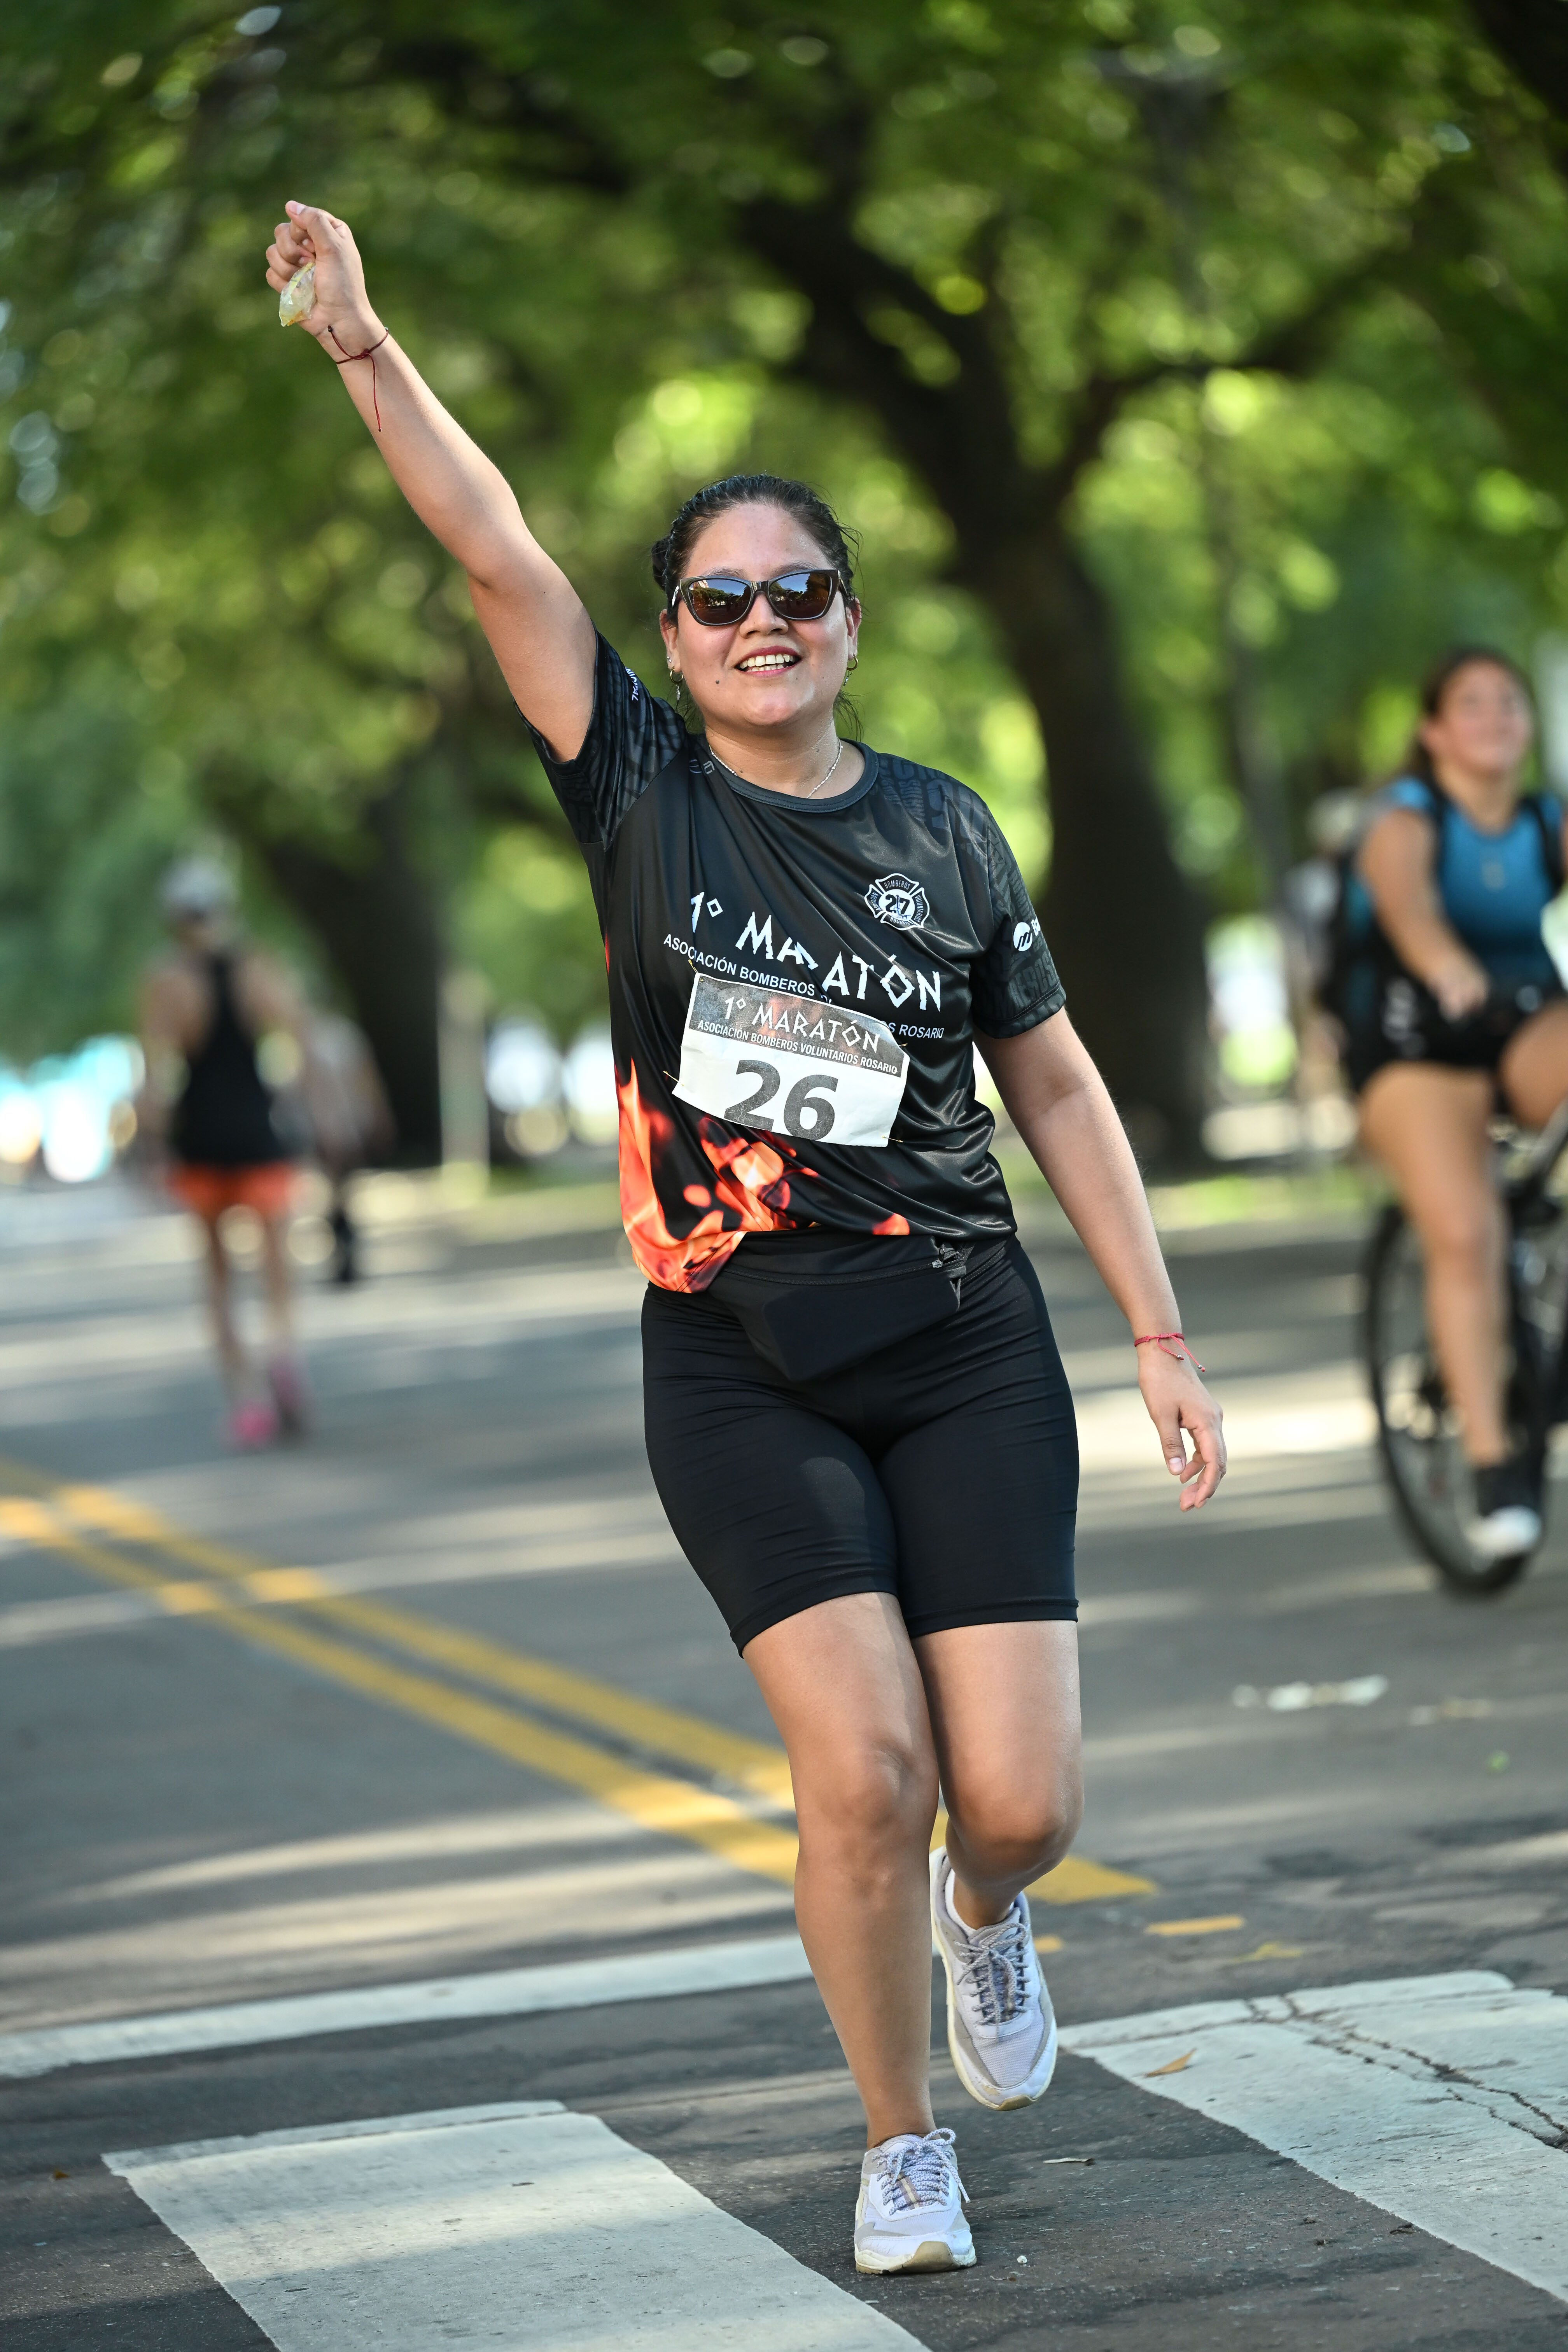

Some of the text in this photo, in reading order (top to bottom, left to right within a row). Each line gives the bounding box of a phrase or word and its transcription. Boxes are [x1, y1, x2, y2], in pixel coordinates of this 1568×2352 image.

[884, 880, 911, 890] BOMBEROS
[885, 894, 910, 915] 27
[914, 894, 924, 922] VOLUNTARIOS
[663, 934, 737, 975] ASOCIACIÓN
[739, 966, 815, 996] BOMBEROS
[898, 1024, 945, 1039] ROSARIO
[697, 1020, 898, 1074] ASOCIACIÓN BOMBEROS VOLUNTARIOS ROSARIO
[751, 1002, 880, 1054] MARATÓN
[724, 1059, 839, 1141] 26
